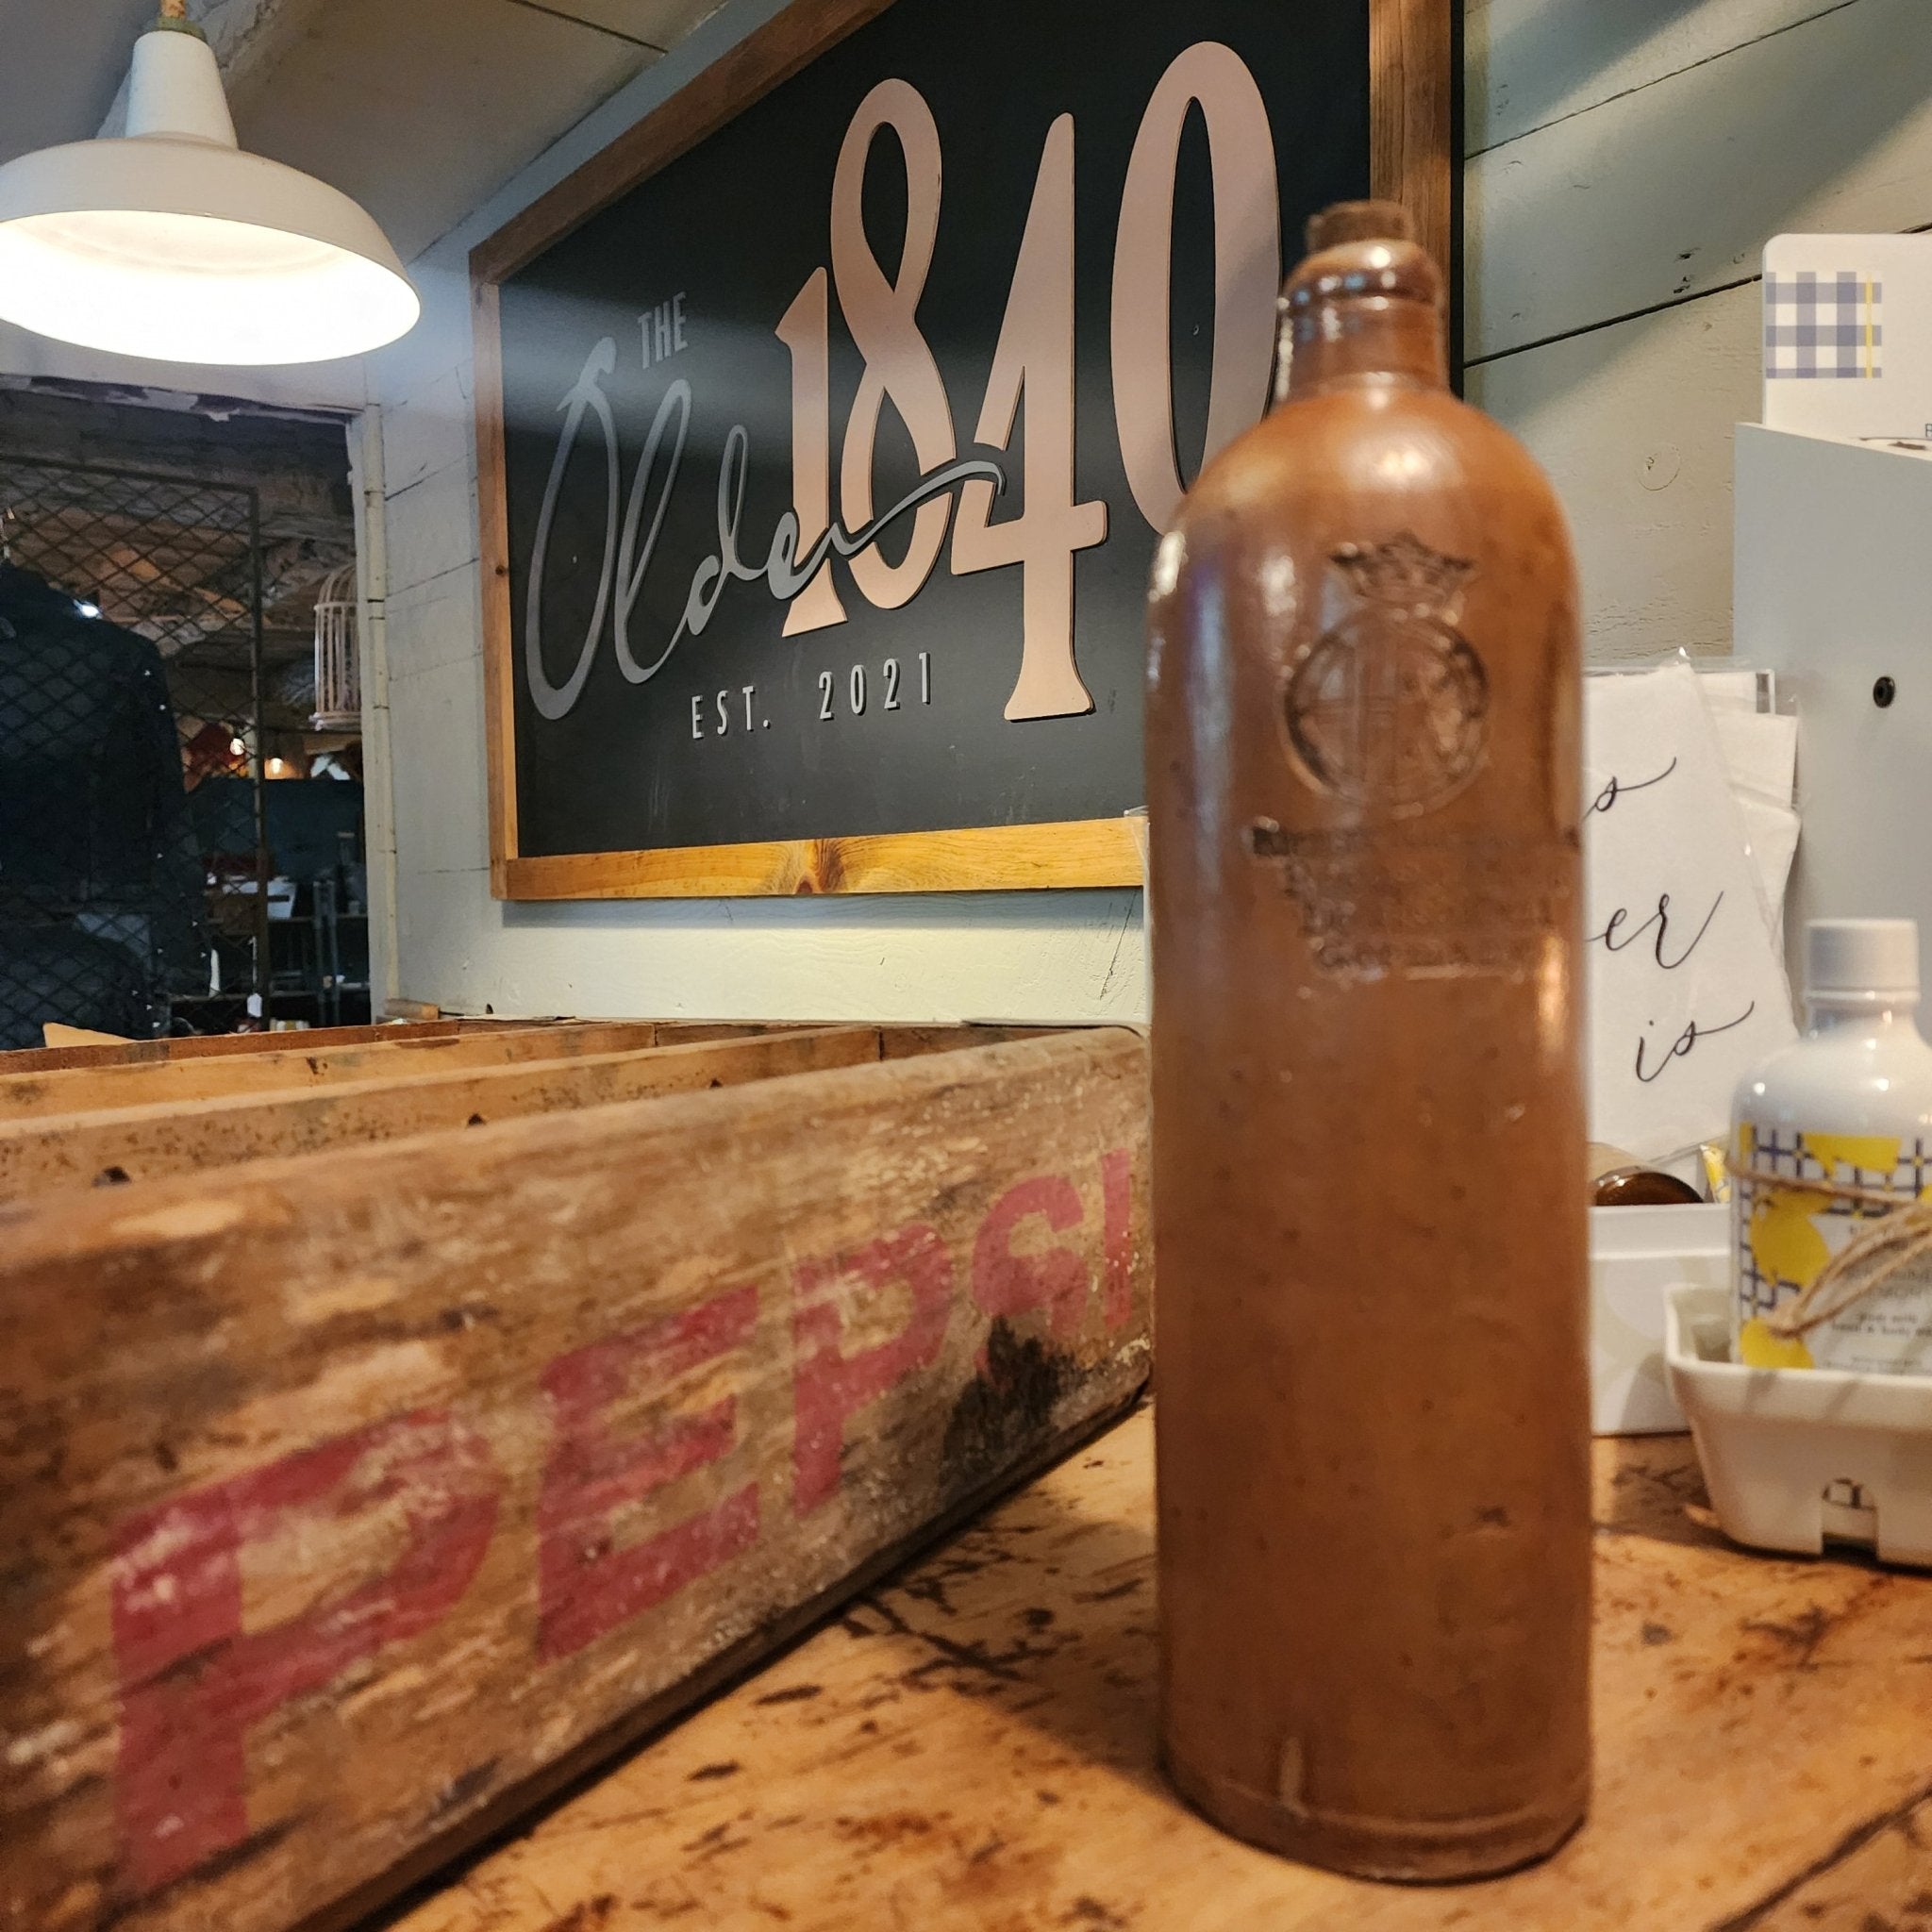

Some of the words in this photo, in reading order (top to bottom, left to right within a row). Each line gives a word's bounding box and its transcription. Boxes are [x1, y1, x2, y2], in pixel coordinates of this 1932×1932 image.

[637, 291, 688, 370] THE
[774, 41, 1281, 722] 1840
[691, 685, 771, 740] EST.
[819, 652, 931, 720] 2021
[1585, 891, 1724, 970] er
[108, 1147, 1132, 1885] PEPSI
